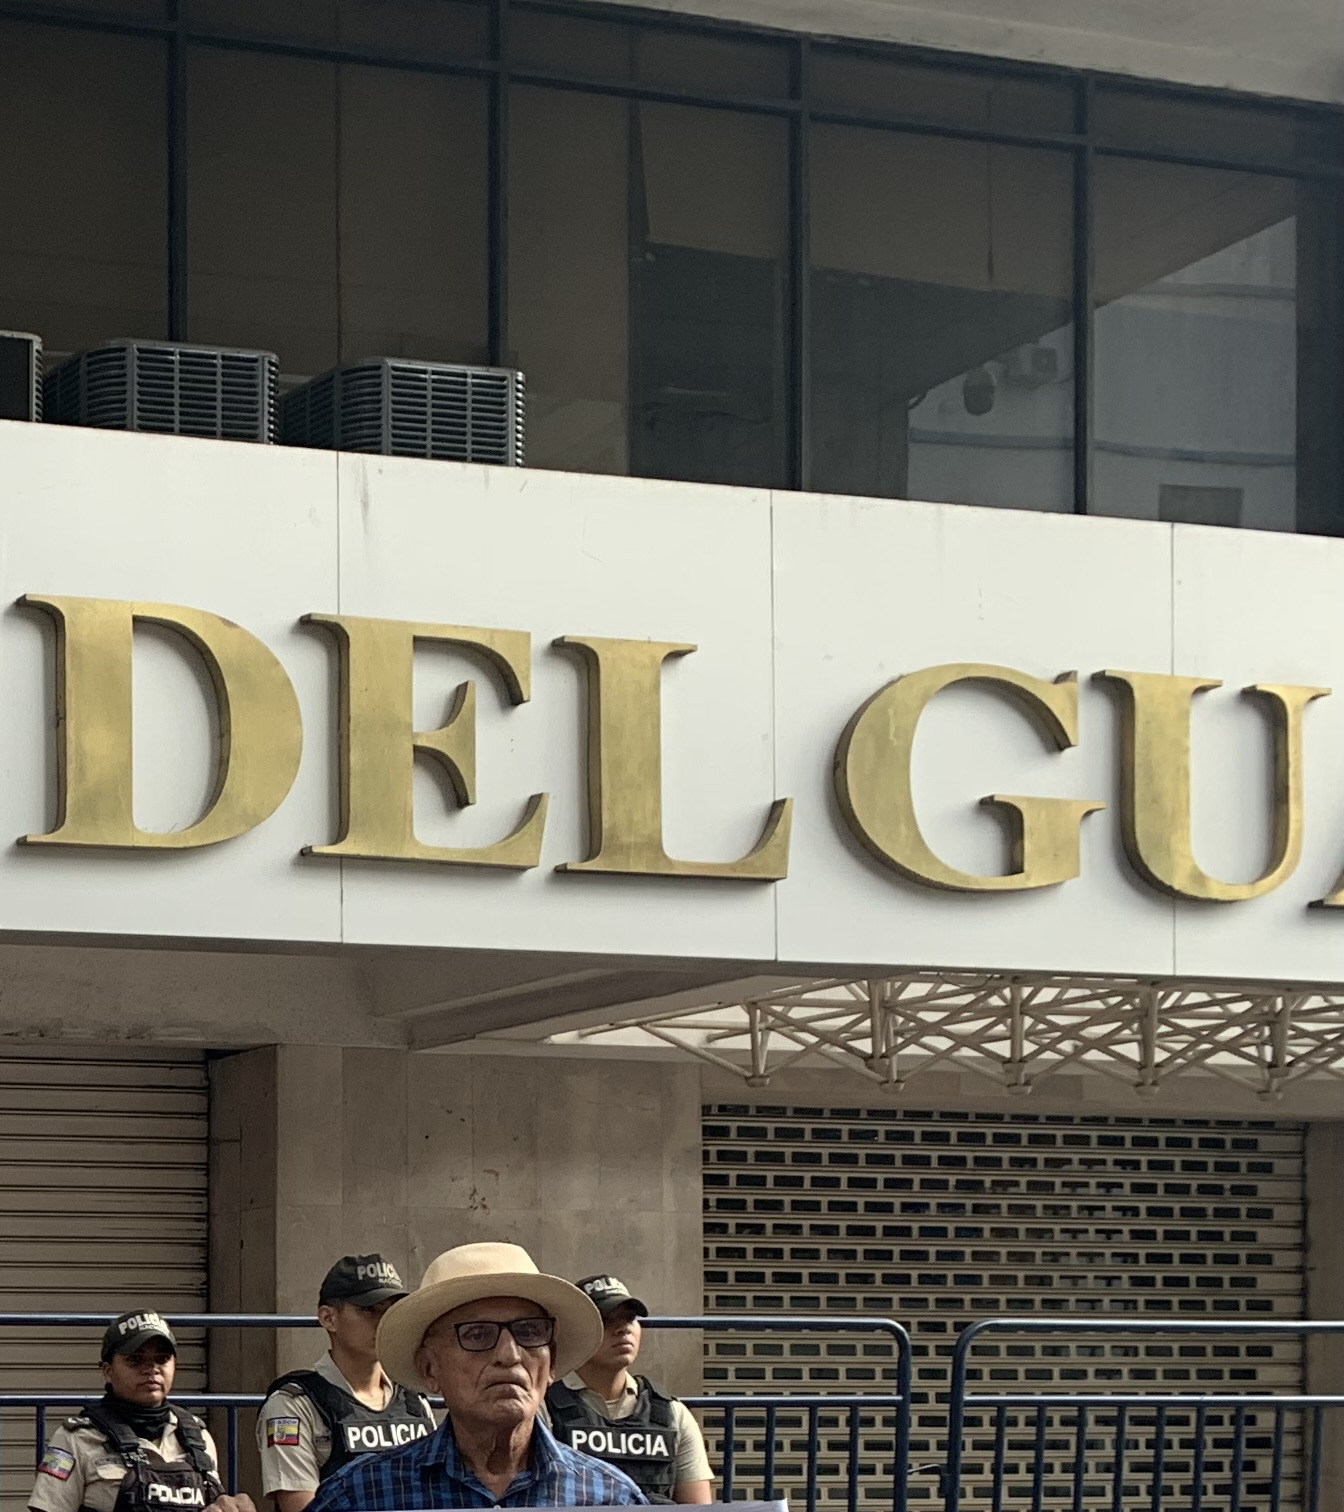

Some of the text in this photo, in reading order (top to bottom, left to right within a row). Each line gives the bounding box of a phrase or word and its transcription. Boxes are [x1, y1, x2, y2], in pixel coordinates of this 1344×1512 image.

[15, 593, 794, 882] DEL
[832, 662, 1344, 908] GU
[347, 1424, 428, 1448] POLICIA
[572, 1430, 669, 1456] POLICIA
[148, 1483, 205, 1506] POLICIA
